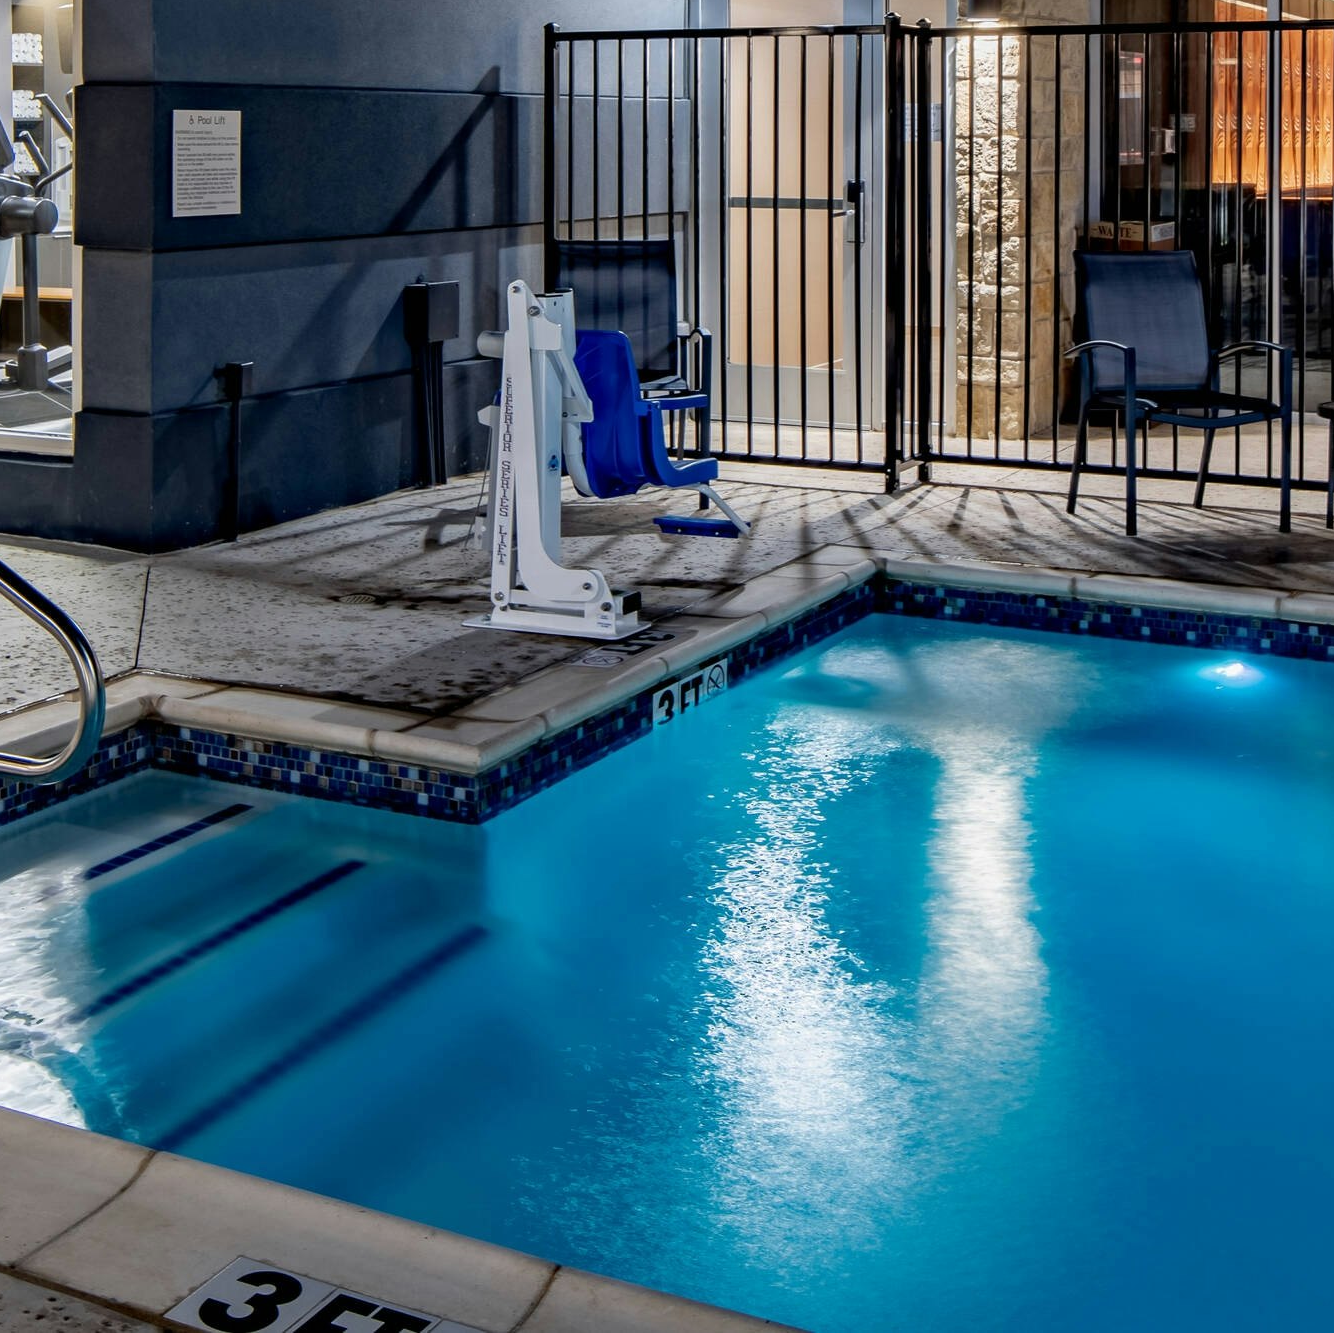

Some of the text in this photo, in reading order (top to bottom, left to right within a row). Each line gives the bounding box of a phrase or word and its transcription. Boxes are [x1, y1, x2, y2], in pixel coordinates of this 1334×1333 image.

[197, 115, 226, 125] Pool Lift
[1097, 225, 1132, 239] WATE
[496, 377, 514, 565] SUPERIOR SERIES LIFT
[198, 1270, 303, 1333] 3
